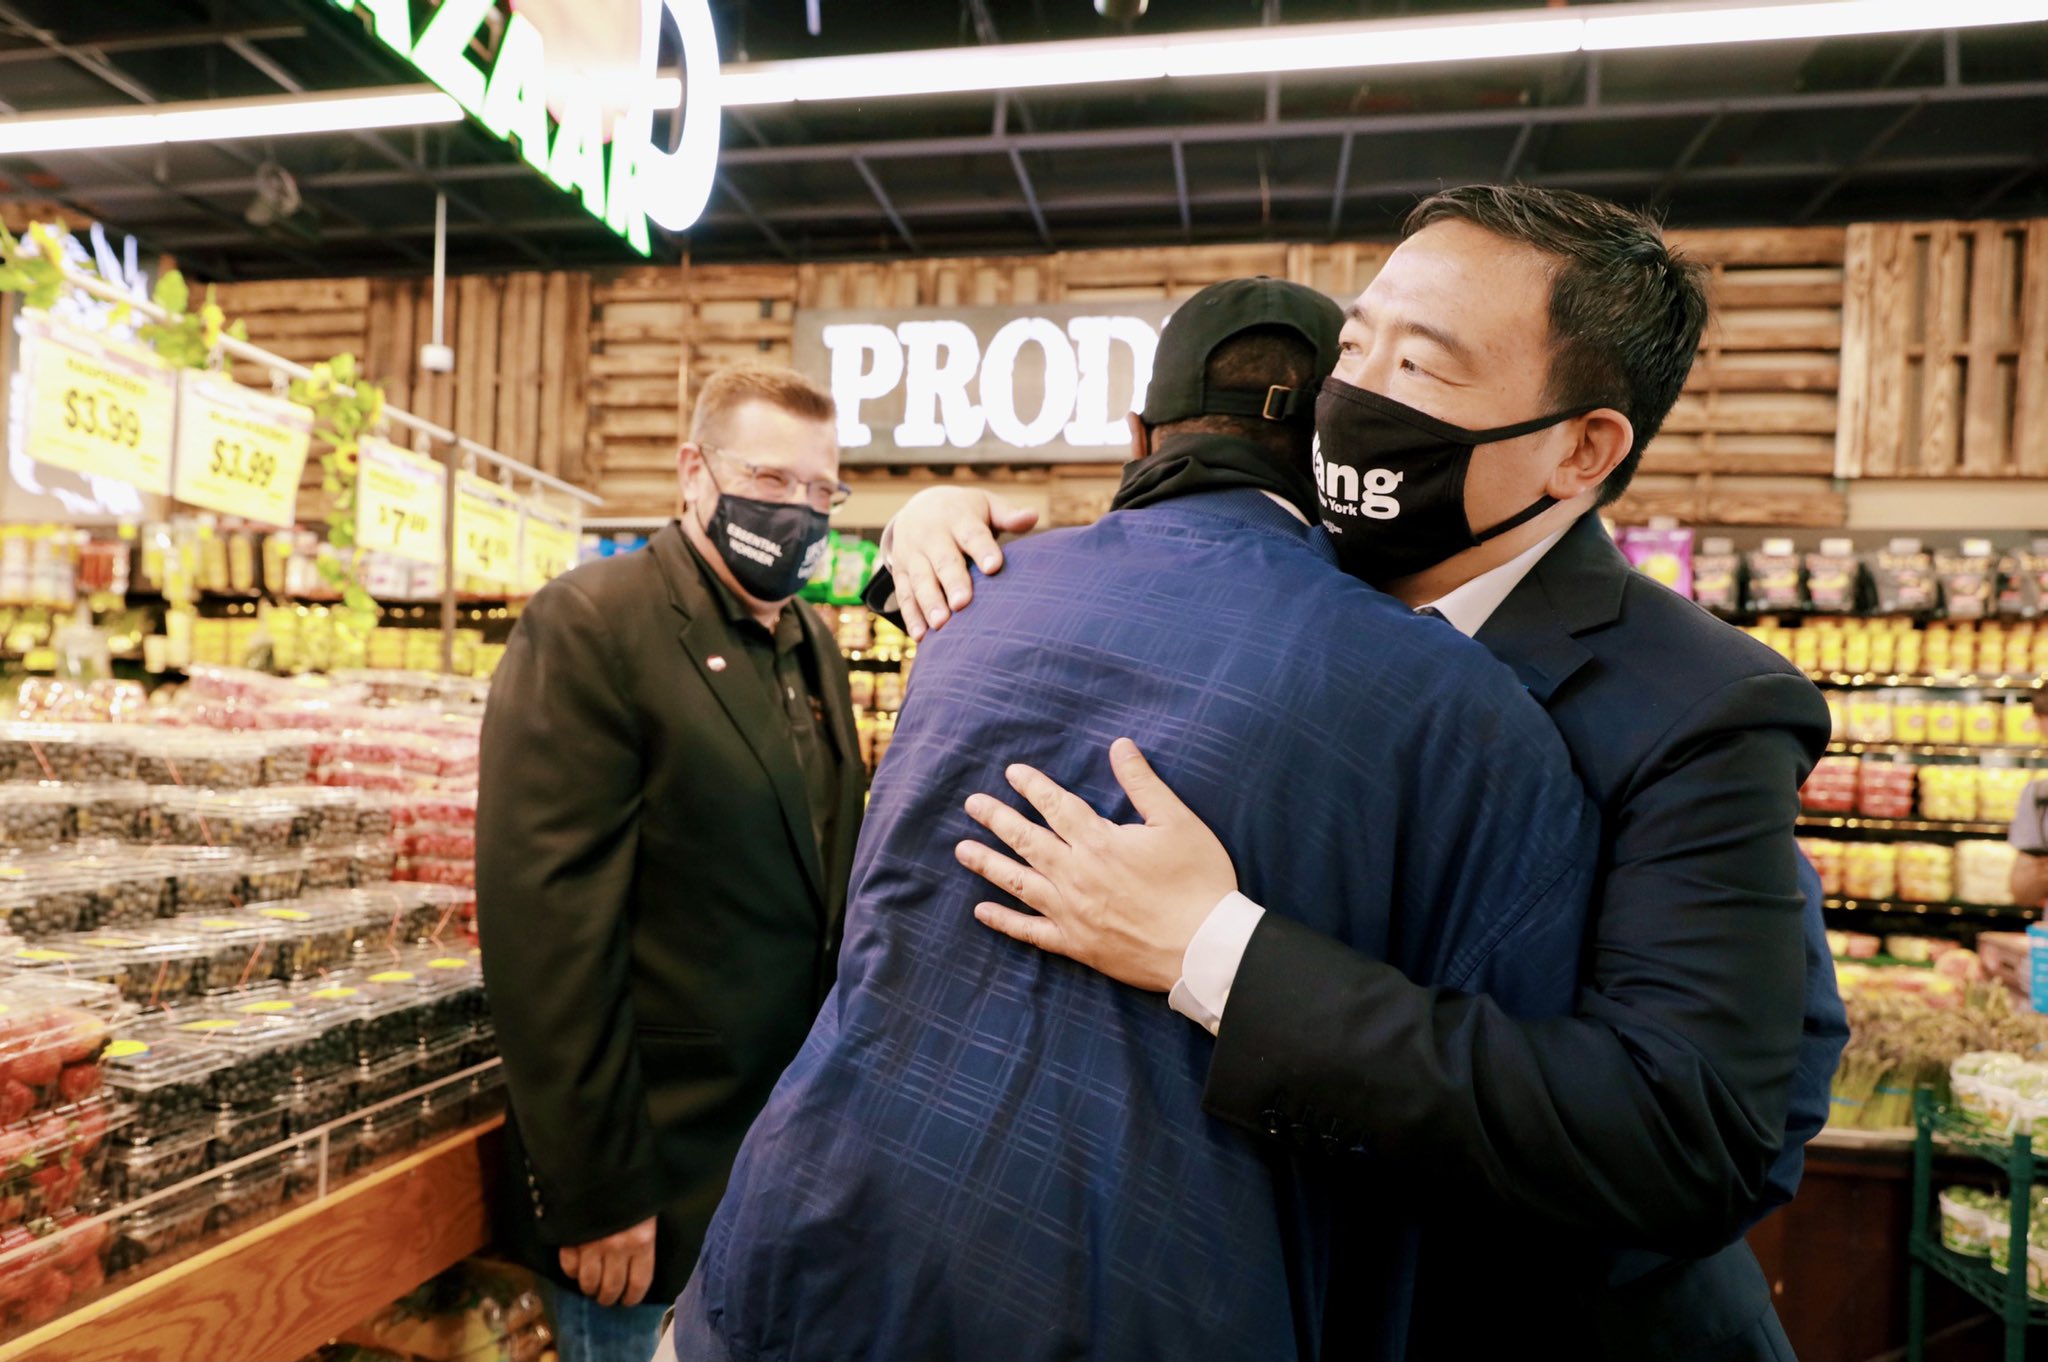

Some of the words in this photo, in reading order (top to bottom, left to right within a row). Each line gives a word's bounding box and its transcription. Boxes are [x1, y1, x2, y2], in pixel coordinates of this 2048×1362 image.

[822, 313, 1172, 448] PROD
[64, 388, 140, 449] $3.99
[210, 437, 278, 489] $3.99
[1327, 498, 1358, 517] York
